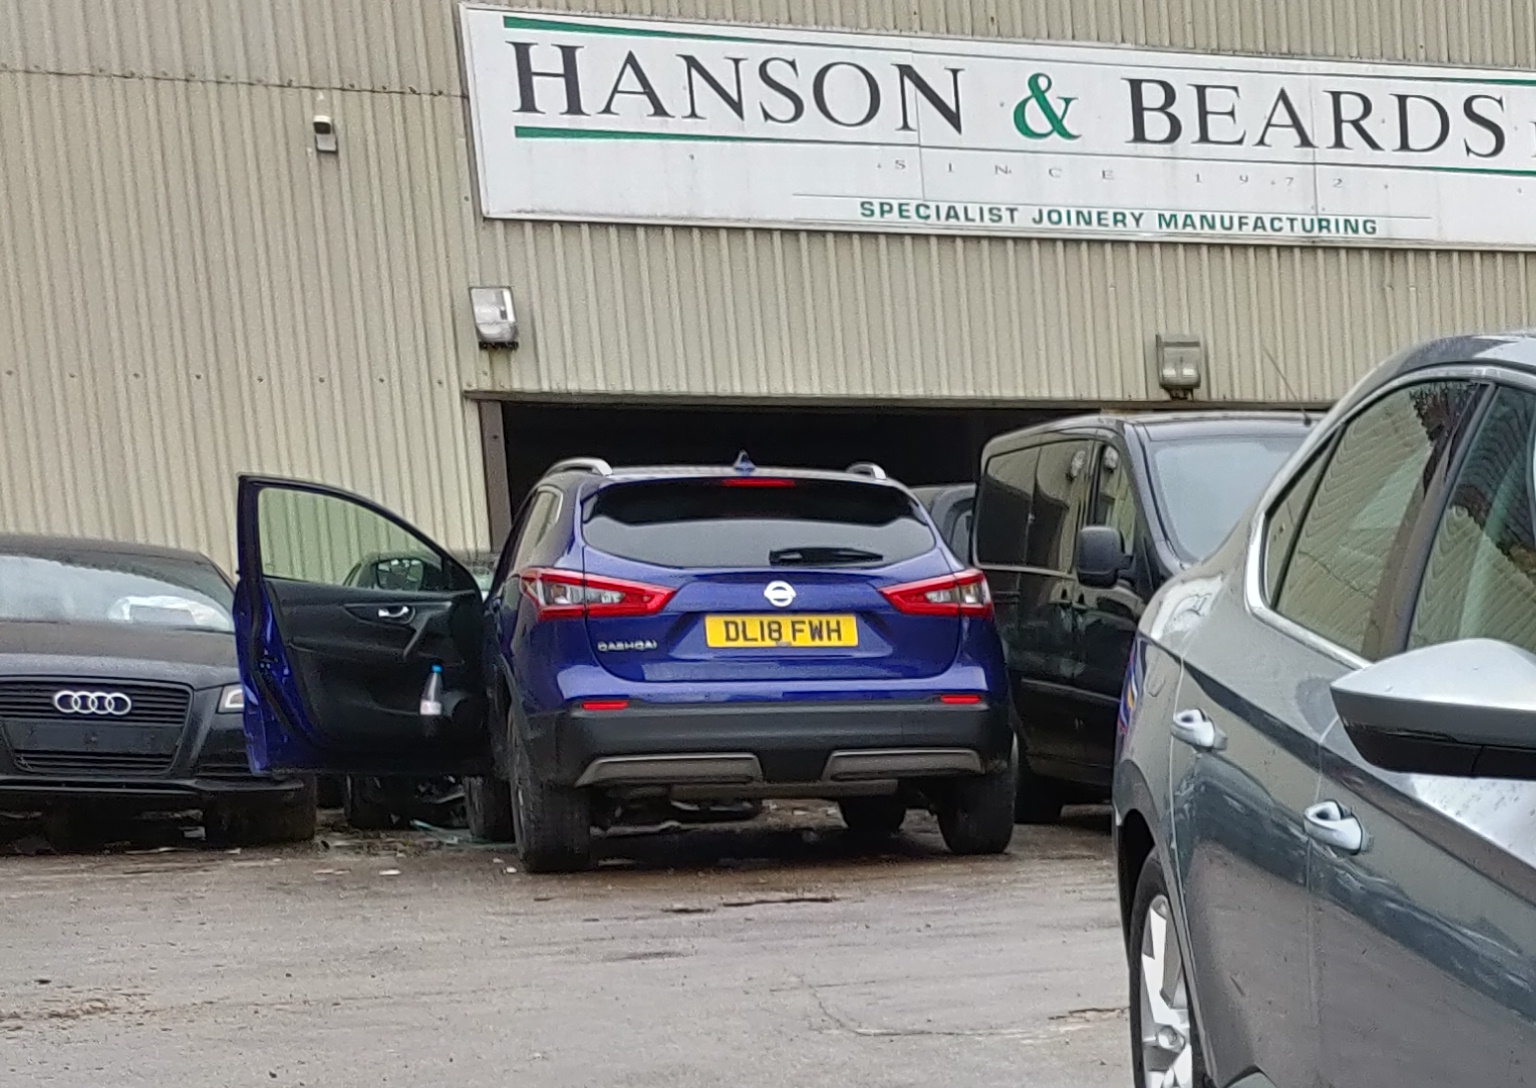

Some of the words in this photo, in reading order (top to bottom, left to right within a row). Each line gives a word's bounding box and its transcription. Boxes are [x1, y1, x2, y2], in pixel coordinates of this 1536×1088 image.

[506, 40, 967, 137] HANSON
[1013, 72, 1082, 141] &
[1121, 77, 1506, 159] BEARDS
[893, 158, 1115, 181] SINCE
[859, 200, 1019, 224] SPECIALIST
[1031, 208, 1145, 229] JOINERY
[1157, 212, 1378, 236] MANUFACTURING
[723, 620, 783, 642] DL18
[790, 619, 843, 642] FWH
